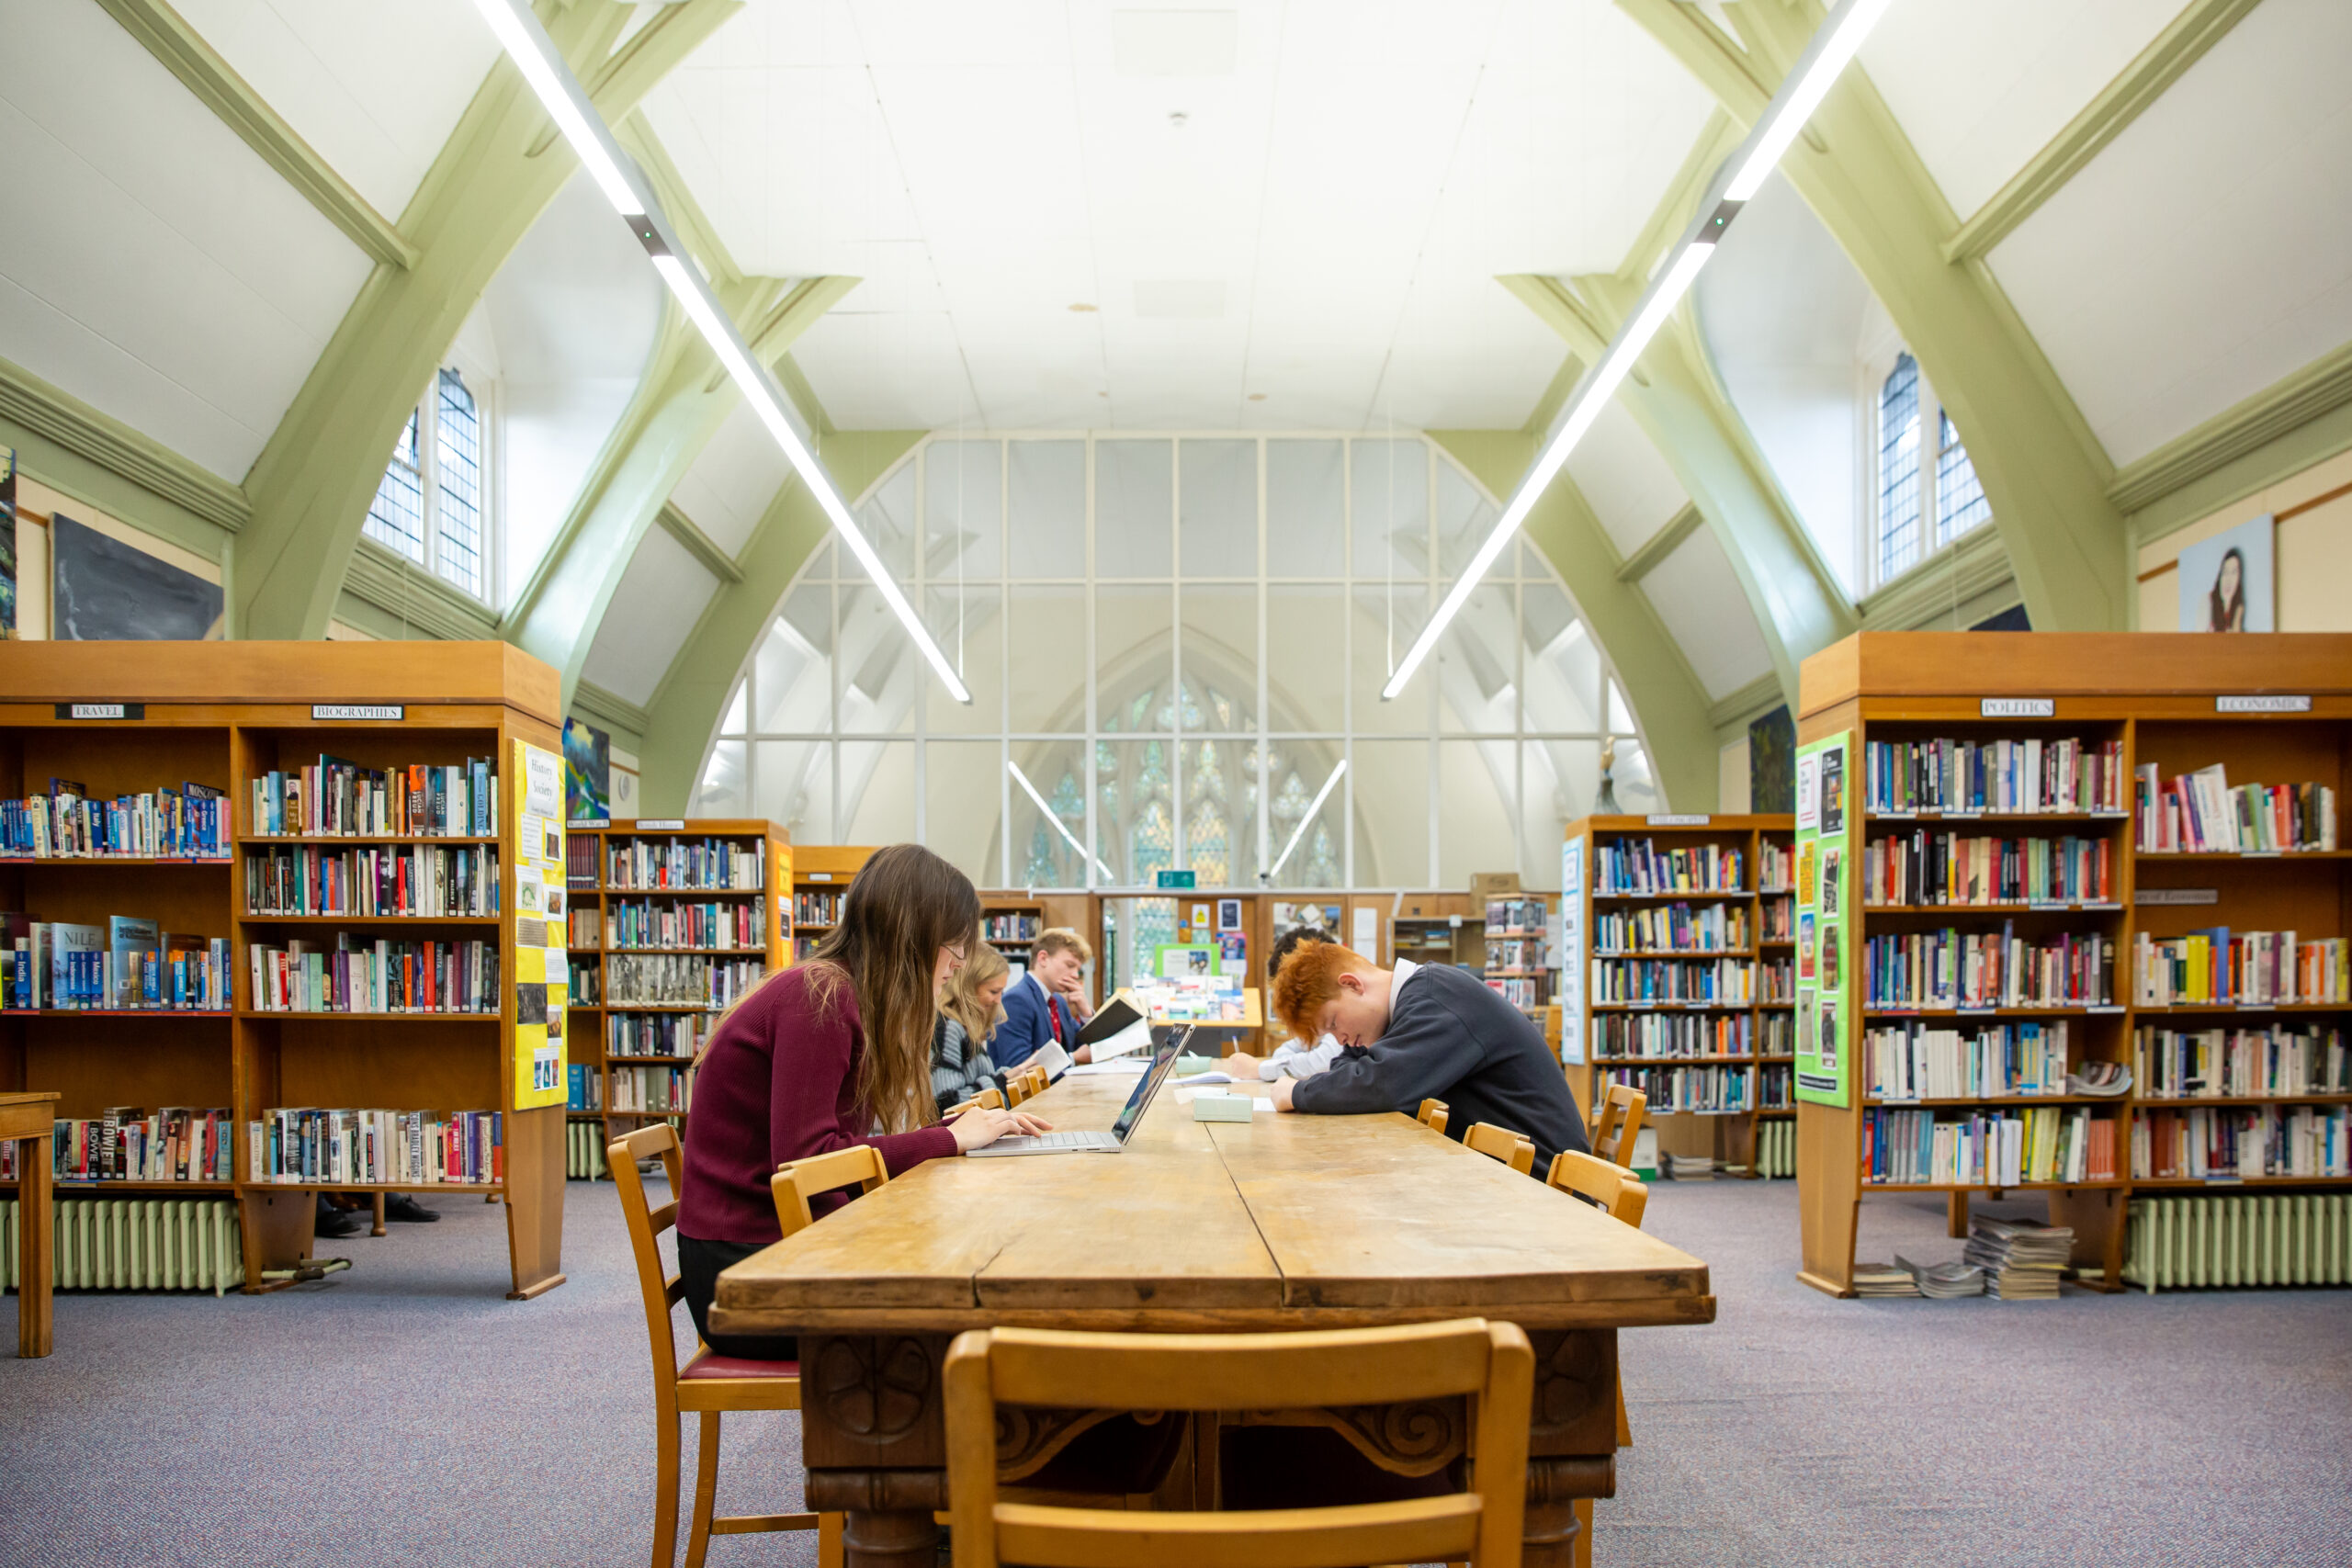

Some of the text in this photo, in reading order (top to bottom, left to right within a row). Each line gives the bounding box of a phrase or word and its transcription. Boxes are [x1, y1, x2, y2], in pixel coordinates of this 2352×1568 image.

[75, 705, 122, 716] TRAVEL
[318, 706, 398, 717] BIOGRAPHIES
[1984, 701, 2052, 715] POLITICS
[2222, 698, 2310, 710] ECONOMICS
[531, 759, 552, 780] History
[533, 782, 552, 800] Society
[92, 813, 101, 827] Italy
[118, 811, 127, 830] Spain
[477, 794, 485, 829] GOLDING
[64, 931, 96, 946] NILE
[17, 961, 27, 982] India
[89, 1127, 98, 1162] BOWIE
[103, 1120, 116, 1158] BOWIE
[411, 1111, 420, 1178] ICONS BRADLEY WIGGINS
